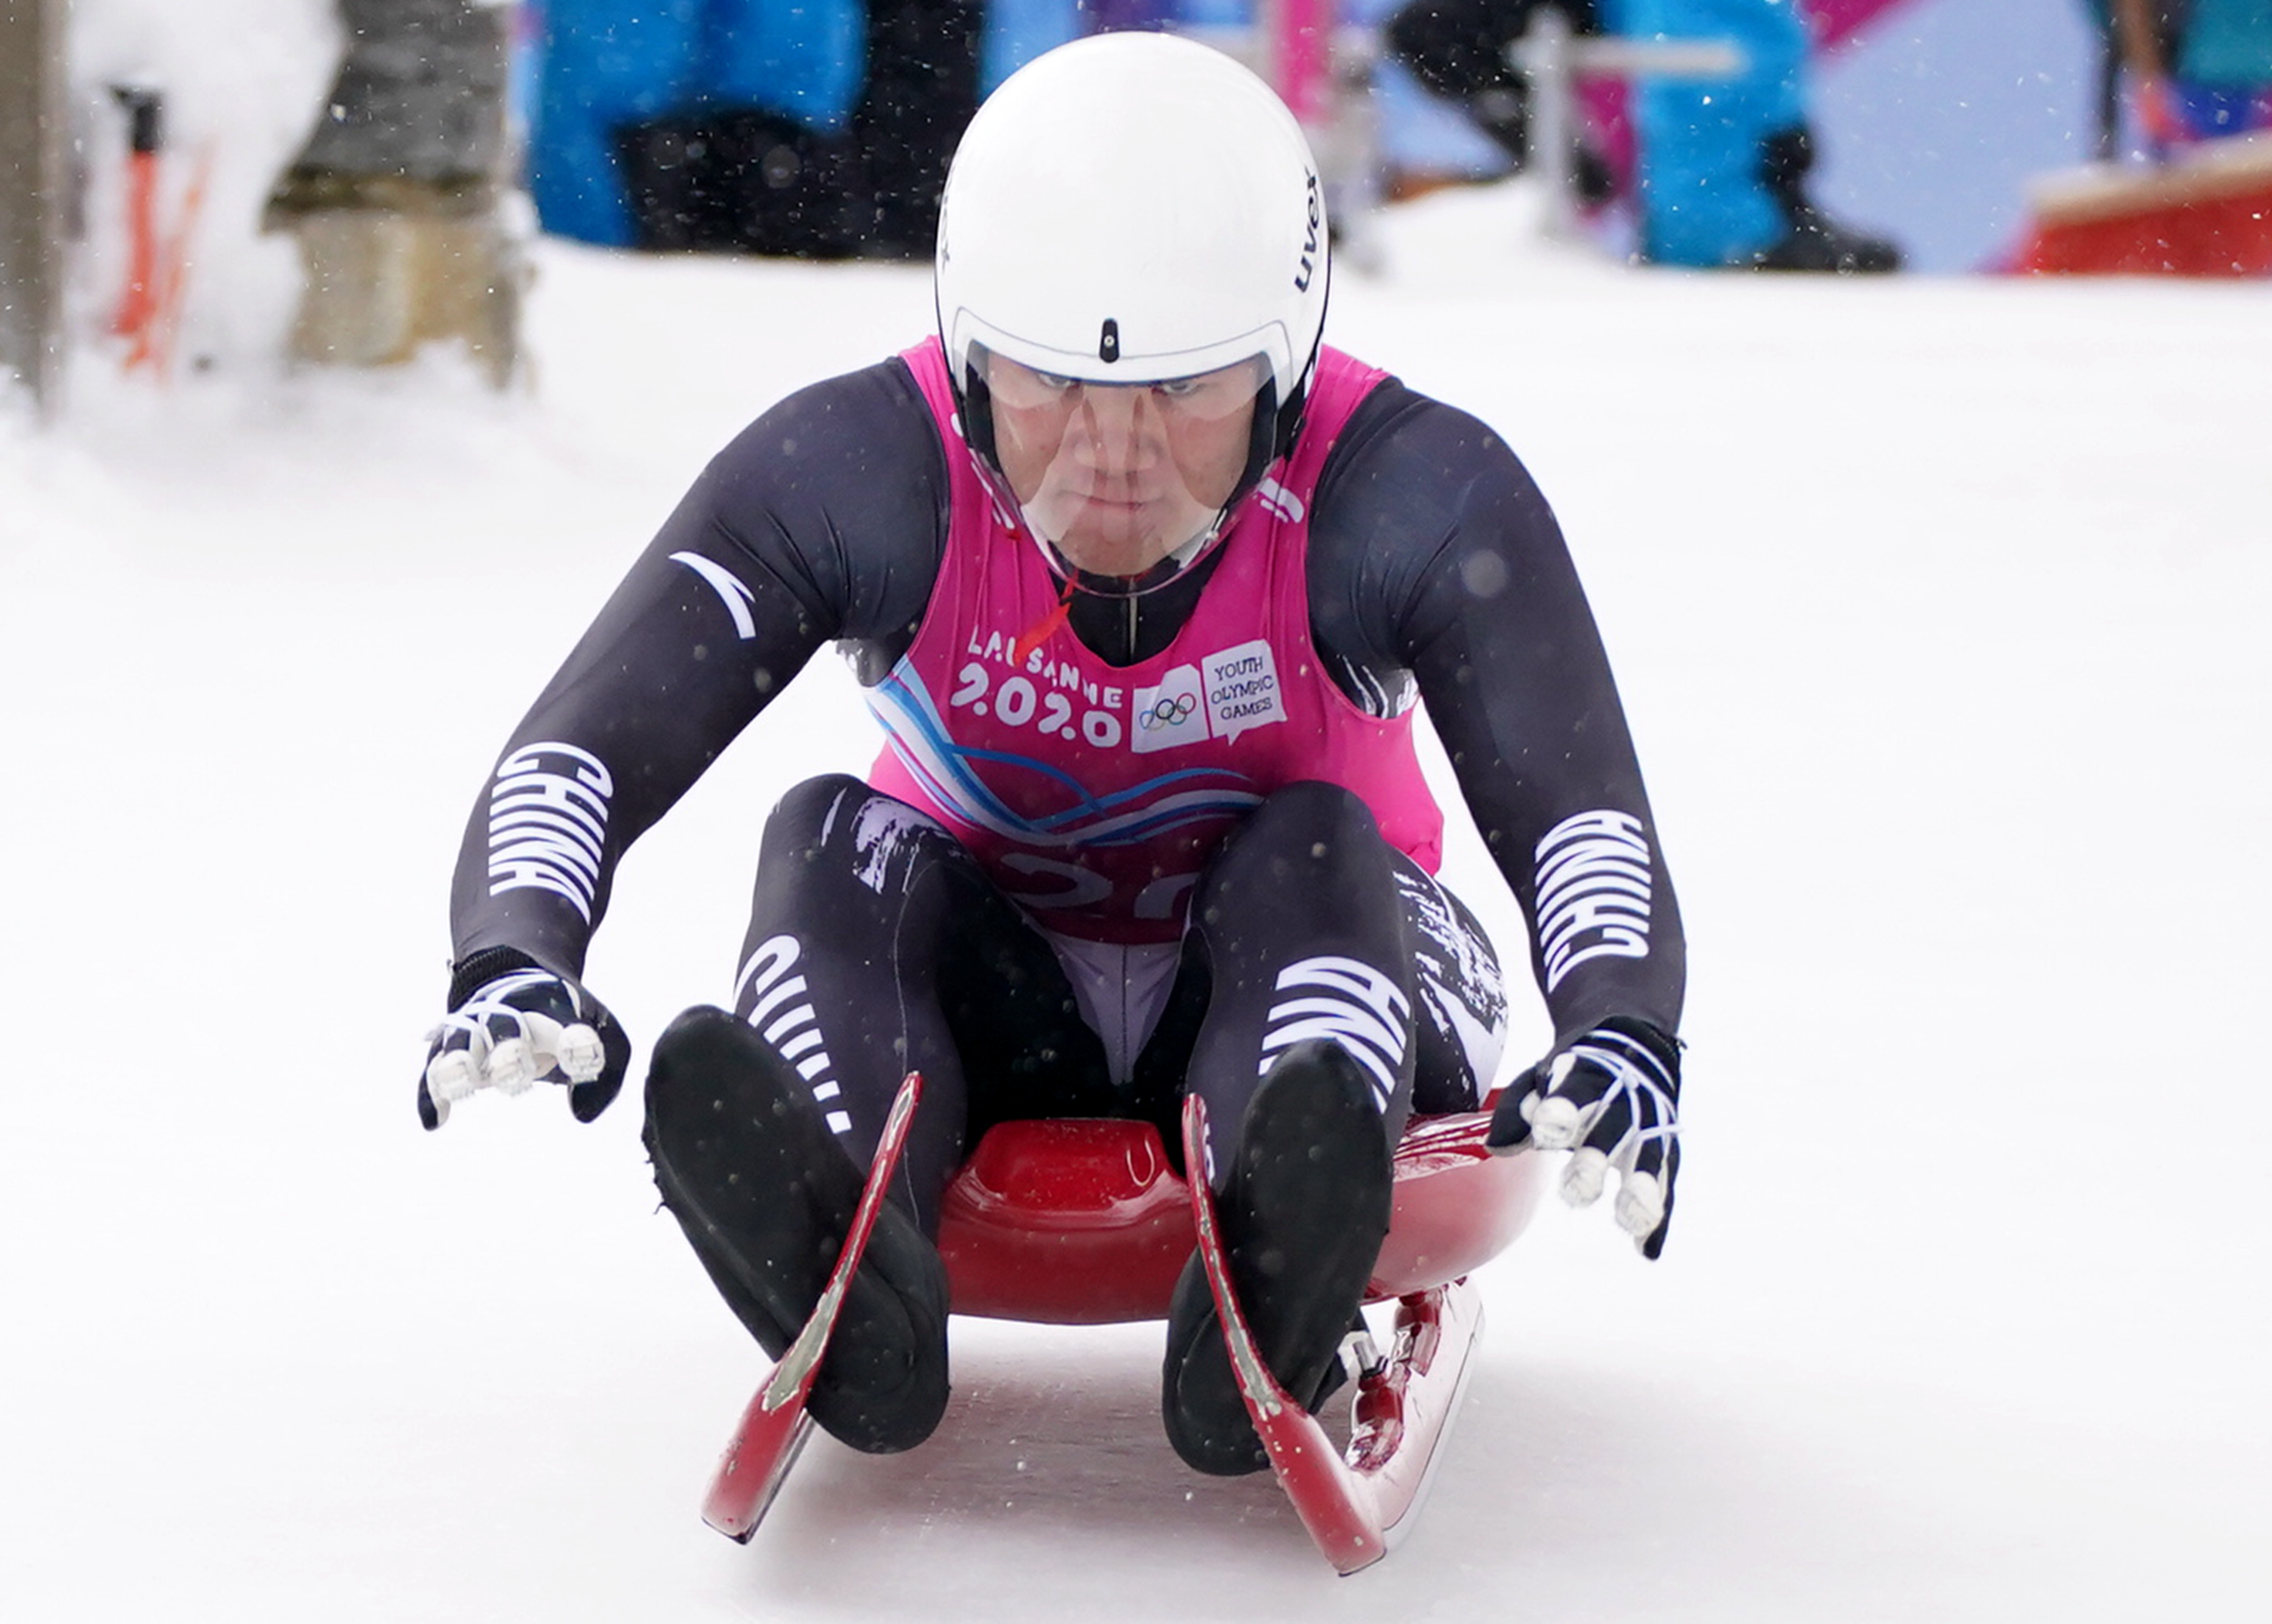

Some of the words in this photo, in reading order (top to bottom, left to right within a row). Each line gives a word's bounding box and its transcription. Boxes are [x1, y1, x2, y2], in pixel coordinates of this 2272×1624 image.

[1294, 164, 1319, 293] uvex
[950, 662, 1122, 747] 2020
[1211, 675, 1274, 704] OLYMPIC
[1215, 657, 1263, 681] YOUTH
[1221, 697, 1272, 719] GAMES
[489, 741, 613, 927] CHINA
[1536, 809, 1652, 994] CHINA
